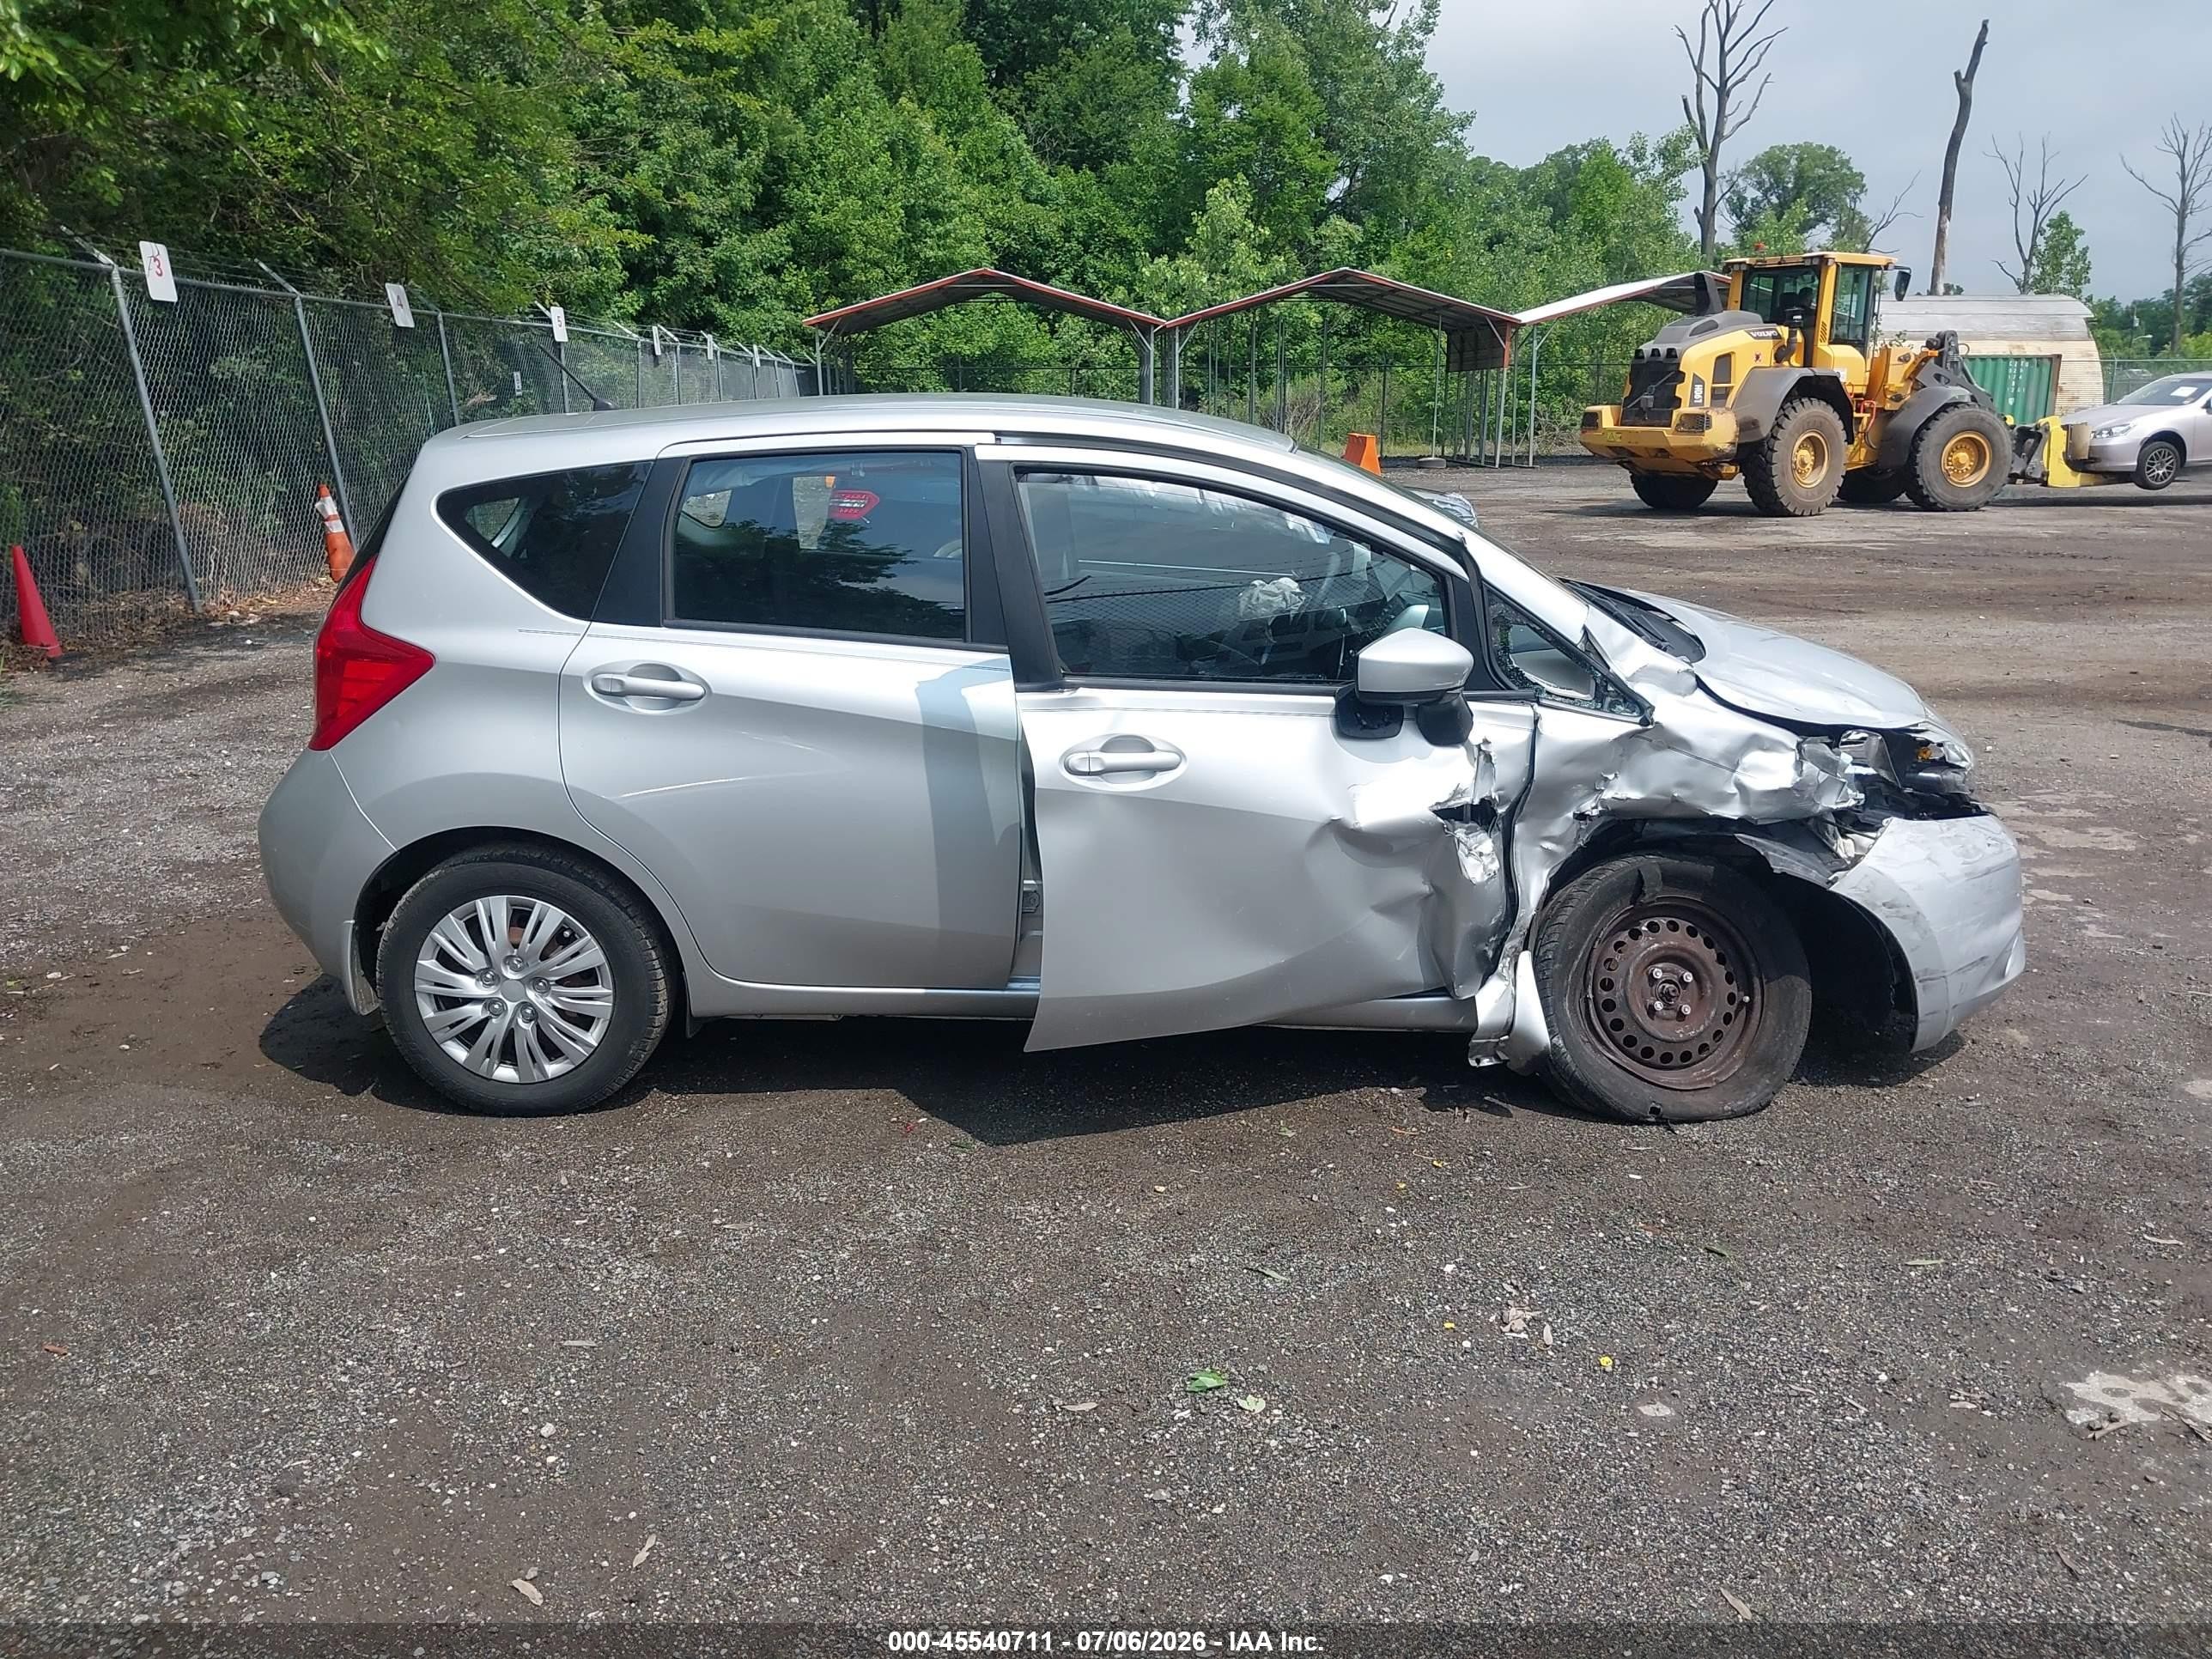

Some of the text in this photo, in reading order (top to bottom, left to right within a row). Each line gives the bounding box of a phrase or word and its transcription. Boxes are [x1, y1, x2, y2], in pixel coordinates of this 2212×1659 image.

[154, 257, 163, 276] 3
[397, 295, 404, 310] 4
[556, 315, 562, 328] 5
